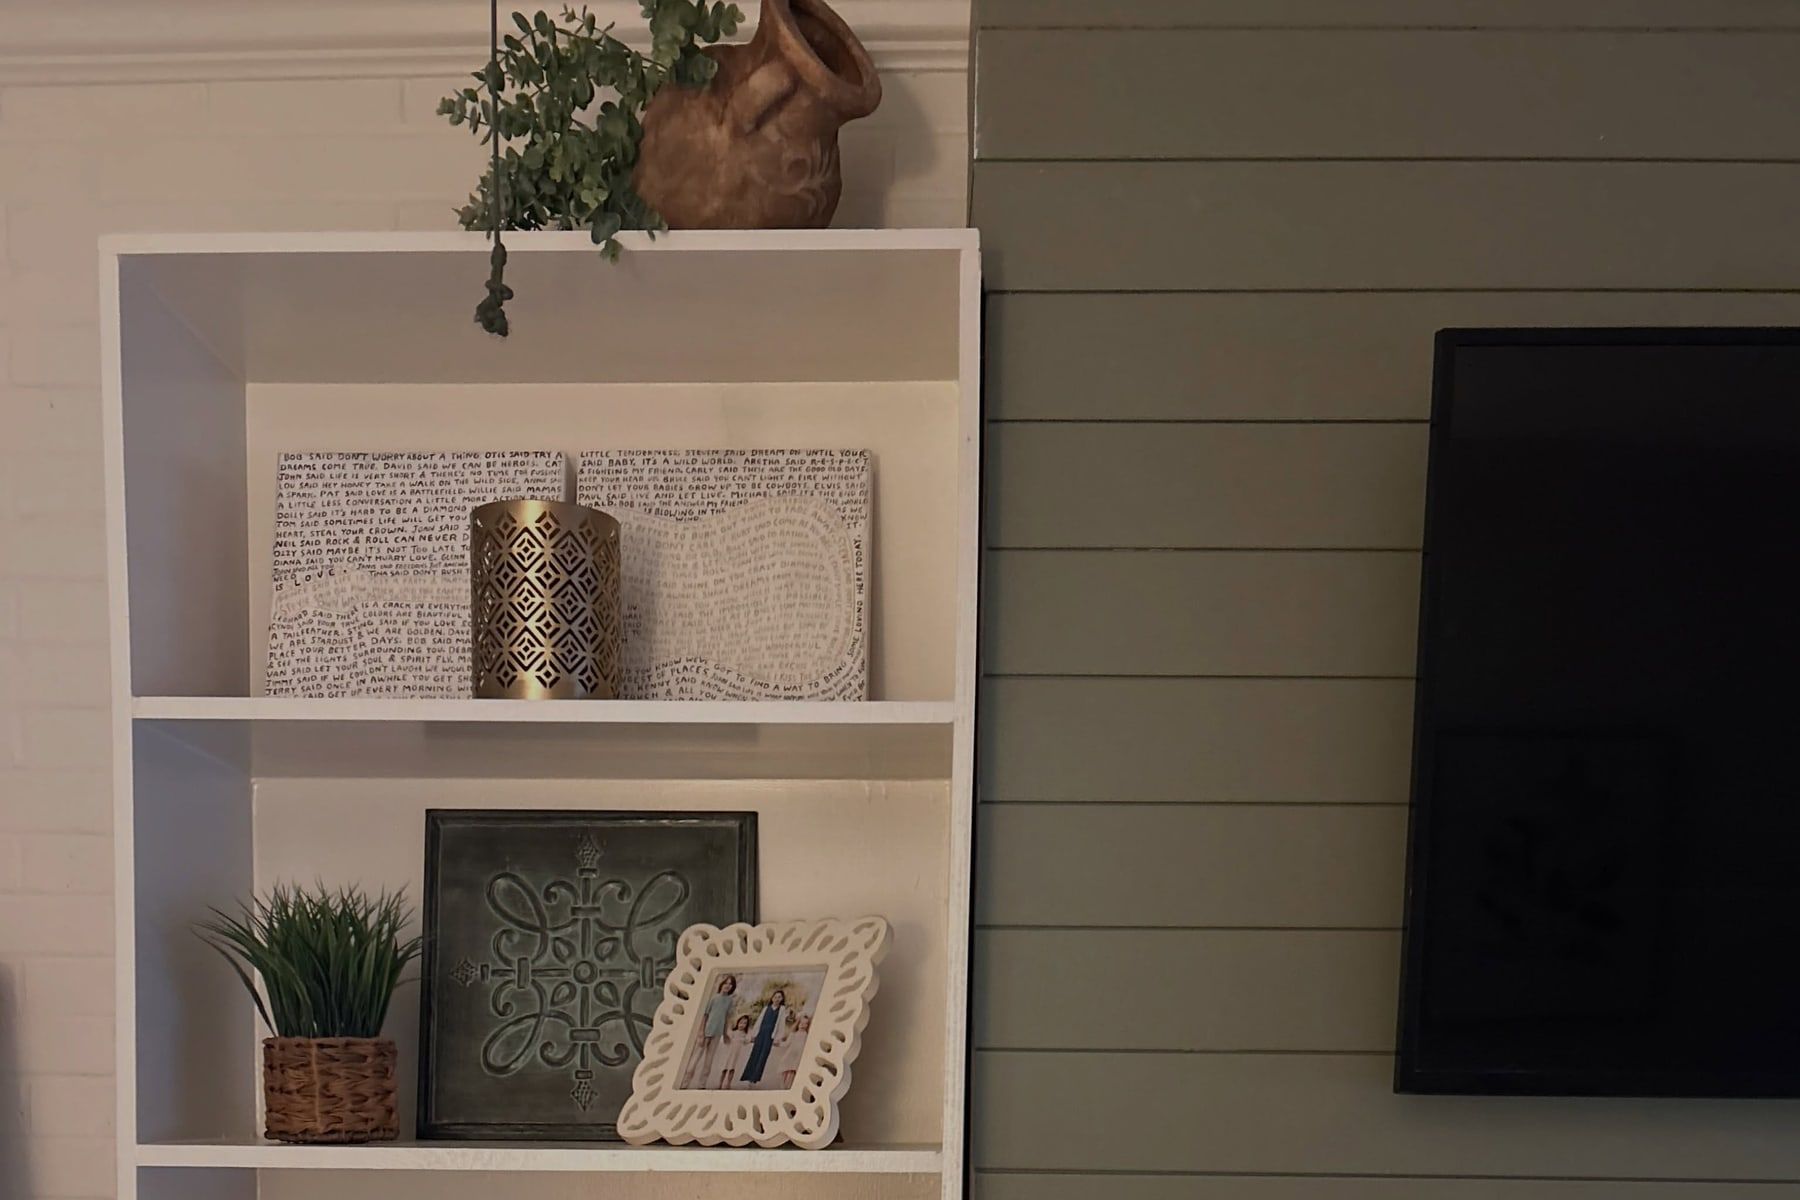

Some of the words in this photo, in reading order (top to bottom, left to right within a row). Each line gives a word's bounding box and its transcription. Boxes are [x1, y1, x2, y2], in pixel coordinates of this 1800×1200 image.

[372, 452, 404, 461] WORRY
[840, 449, 867, 458] YOUR
[642, 457, 657, 466] IT'S
[280, 463, 316, 471] DREAMS
[278, 472, 302, 480] JOHN
[720, 498, 748, 507] FRIEND
[308, 510, 328, 518] SAID
[350, 508, 375, 516] HARD
[424, 506, 467, 514] DIAMOND
[654, 508, 694, 518] BLOWING
[300, 520, 320, 528] SAID
[310, 529, 338, 537] STEAL
[369, 526, 408, 534] CROWN.
[439, 524, 460, 532] SAID
[300, 540, 321, 548] SAID
[326, 538, 350, 546] ROCK
[366, 536, 389, 544] ROLL
[394, 536, 415, 544] CAN
[418, 534, 457, 542] NEVER
[301, 548, 323, 557] SAID
[326, 547, 360, 555] MAYBE
[386, 546, 408, 554] NOT
[432, 544, 456, 553] LATE
[346, 555, 372, 563] CAN'T
[312, 610, 333, 618] SAID
[346, 620, 374, 636] STING
[656, 656, 682, 671] KNOW
[714, 663, 732, 675] GOT
[736, 673, 746, 683] TO
[808, 681, 820, 690] TO
[823, 661, 847, 684] BRING
[856, 572, 864, 594] HERE
[311, 636, 354, 646] STARDUST
[269, 650, 295, 661] PLACE
[300, 647, 324, 656] YOUR
[328, 641, 367, 654] BETTER
[336, 661, 358, 672] YOUR
[362, 656, 382, 666] SOUL
[400, 655, 431, 663] SPIRIT
[266, 678, 294, 687] JIMMY
[297, 674, 318, 684] SAID
[392, 664, 422, 672] LAUGH
[670, 664, 710, 677] PLACES
[675, 676, 697, 686] SAID
[265, 688, 296, 696] JERRY
[301, 683, 322, 692] SAID
[326, 681, 351, 690] ONCE
[366, 684, 398, 694] EVERY
[678, 686, 694, 694] ALL
